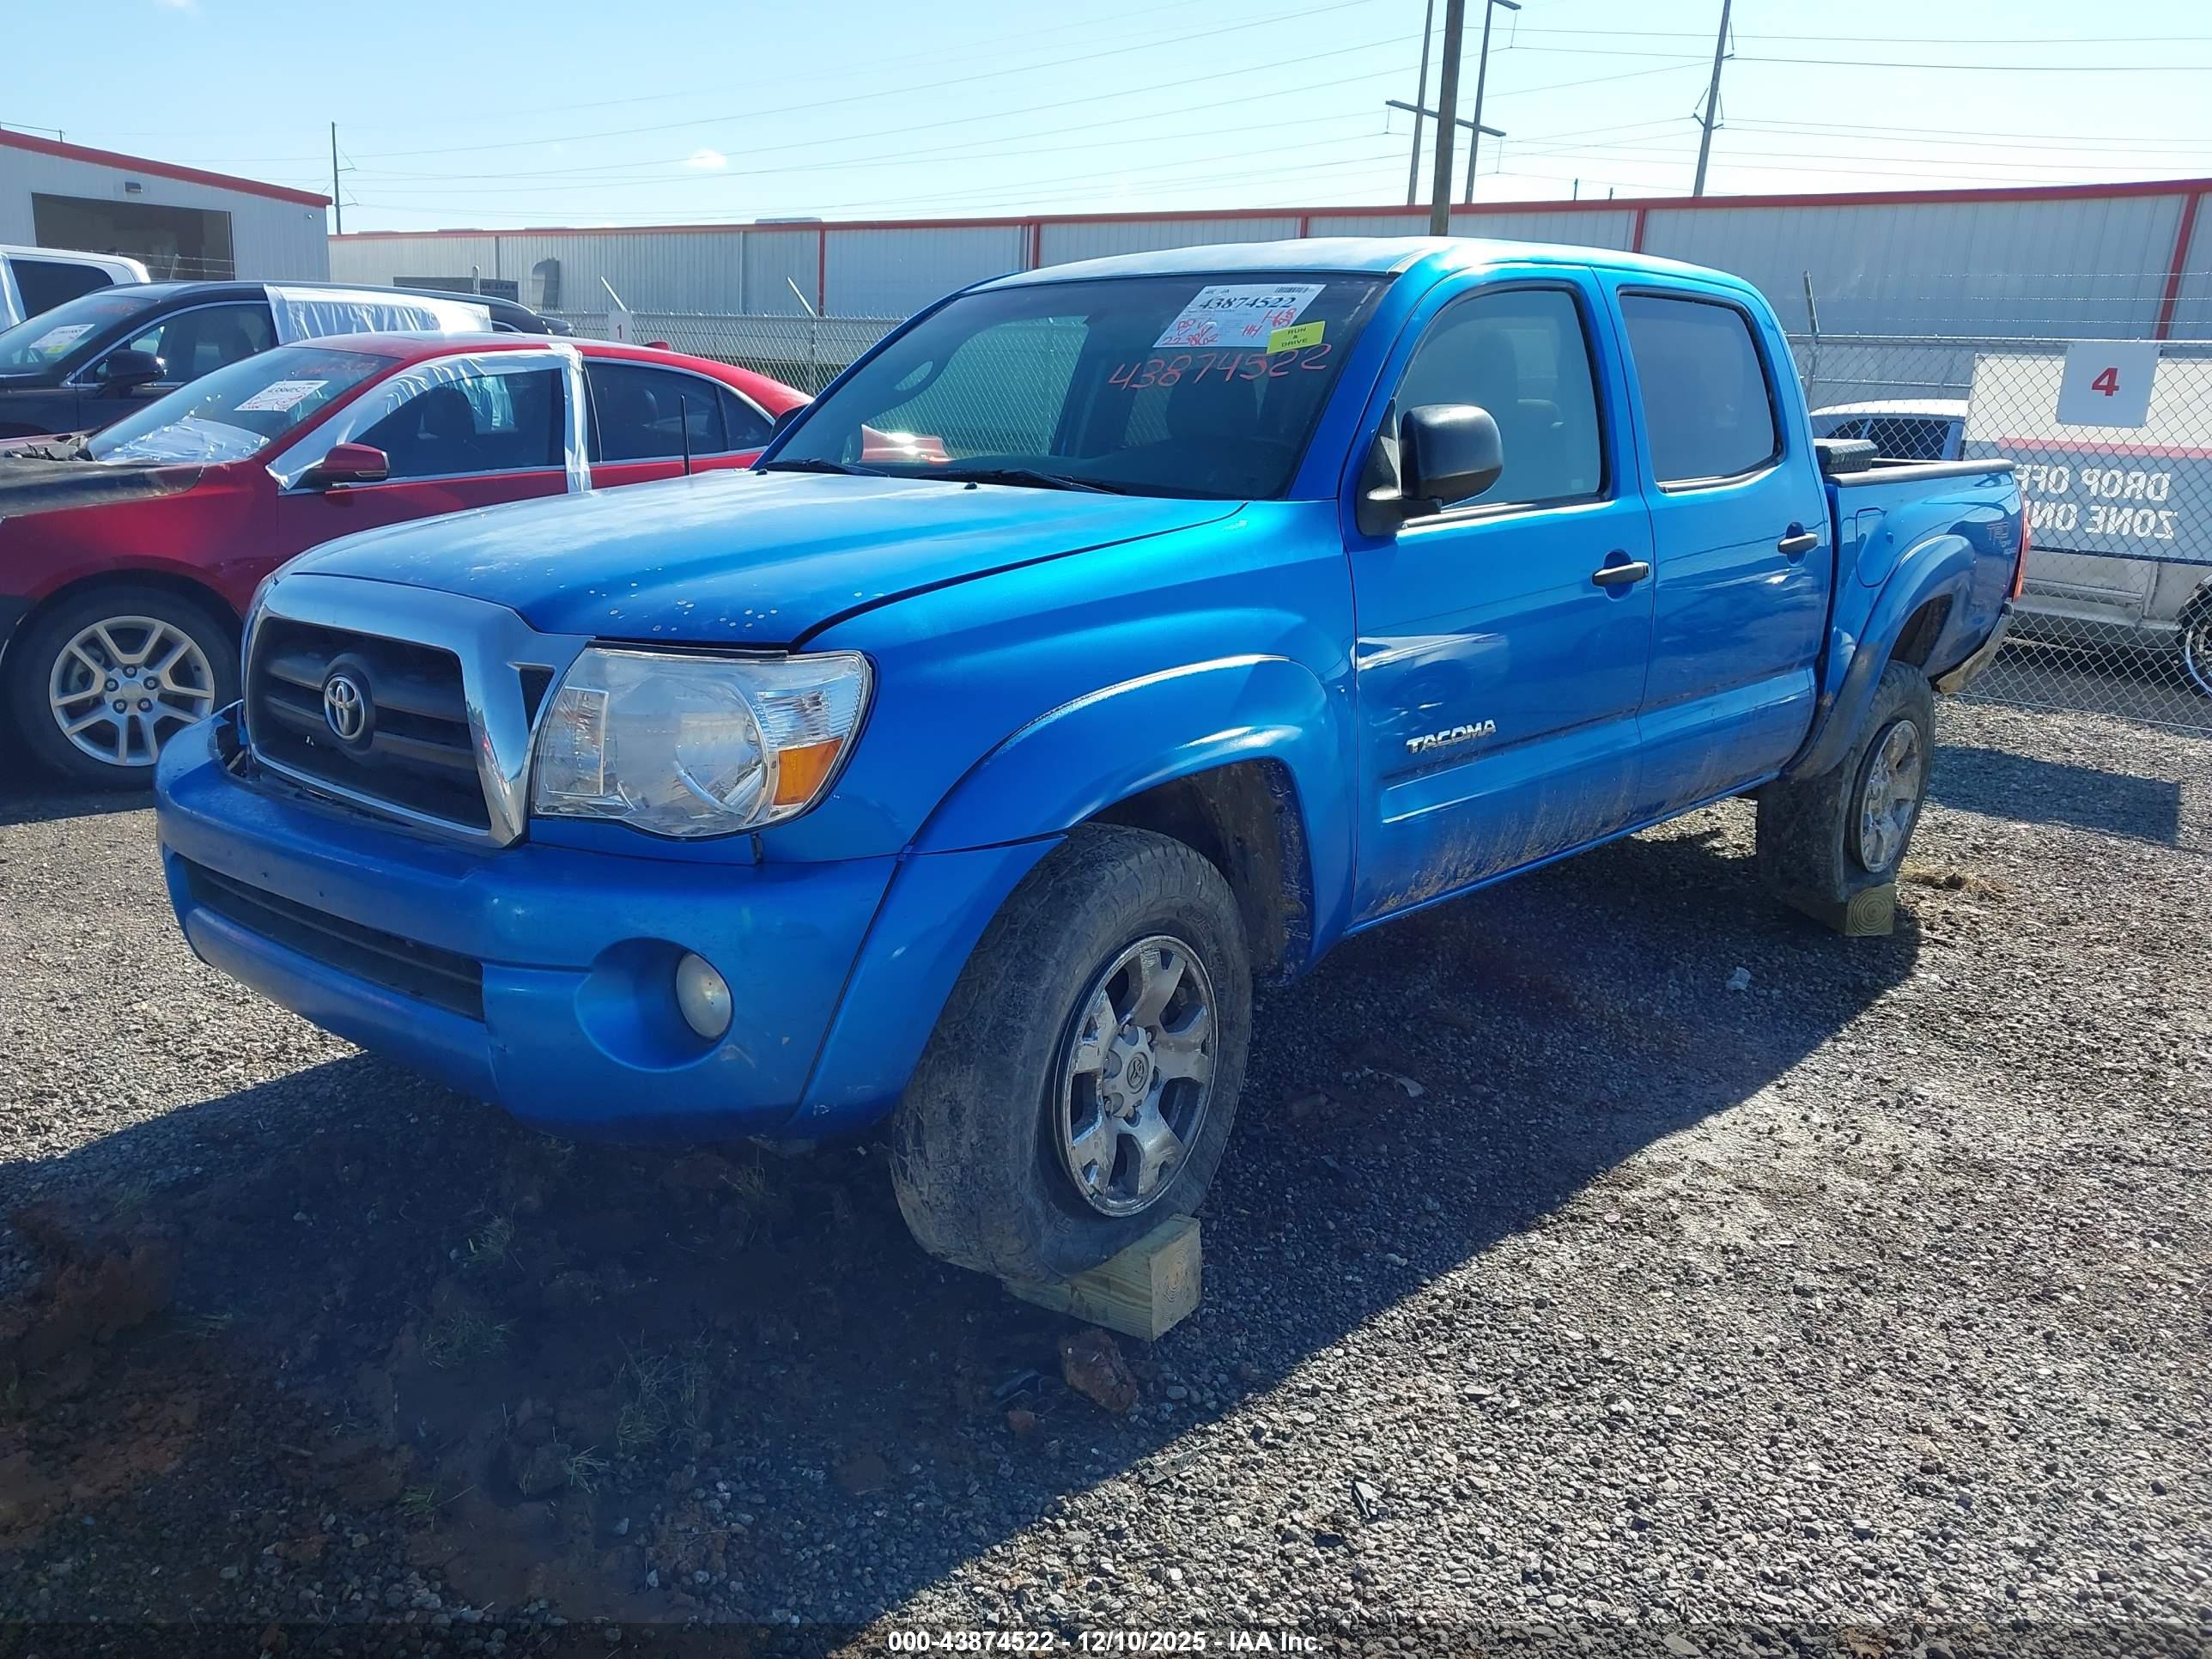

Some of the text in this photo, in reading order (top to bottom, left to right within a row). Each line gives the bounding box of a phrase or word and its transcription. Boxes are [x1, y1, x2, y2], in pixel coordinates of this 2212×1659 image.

[1199, 296, 1297, 309] 43874522
[617, 323, 623, 340] 1
[1281, 338, 1308, 347] DRIVE
[1108, 343, 1333, 391] 43874522
[2091, 367, 2120, 397] 4
[1406, 719, 1497, 755] TACOMA
